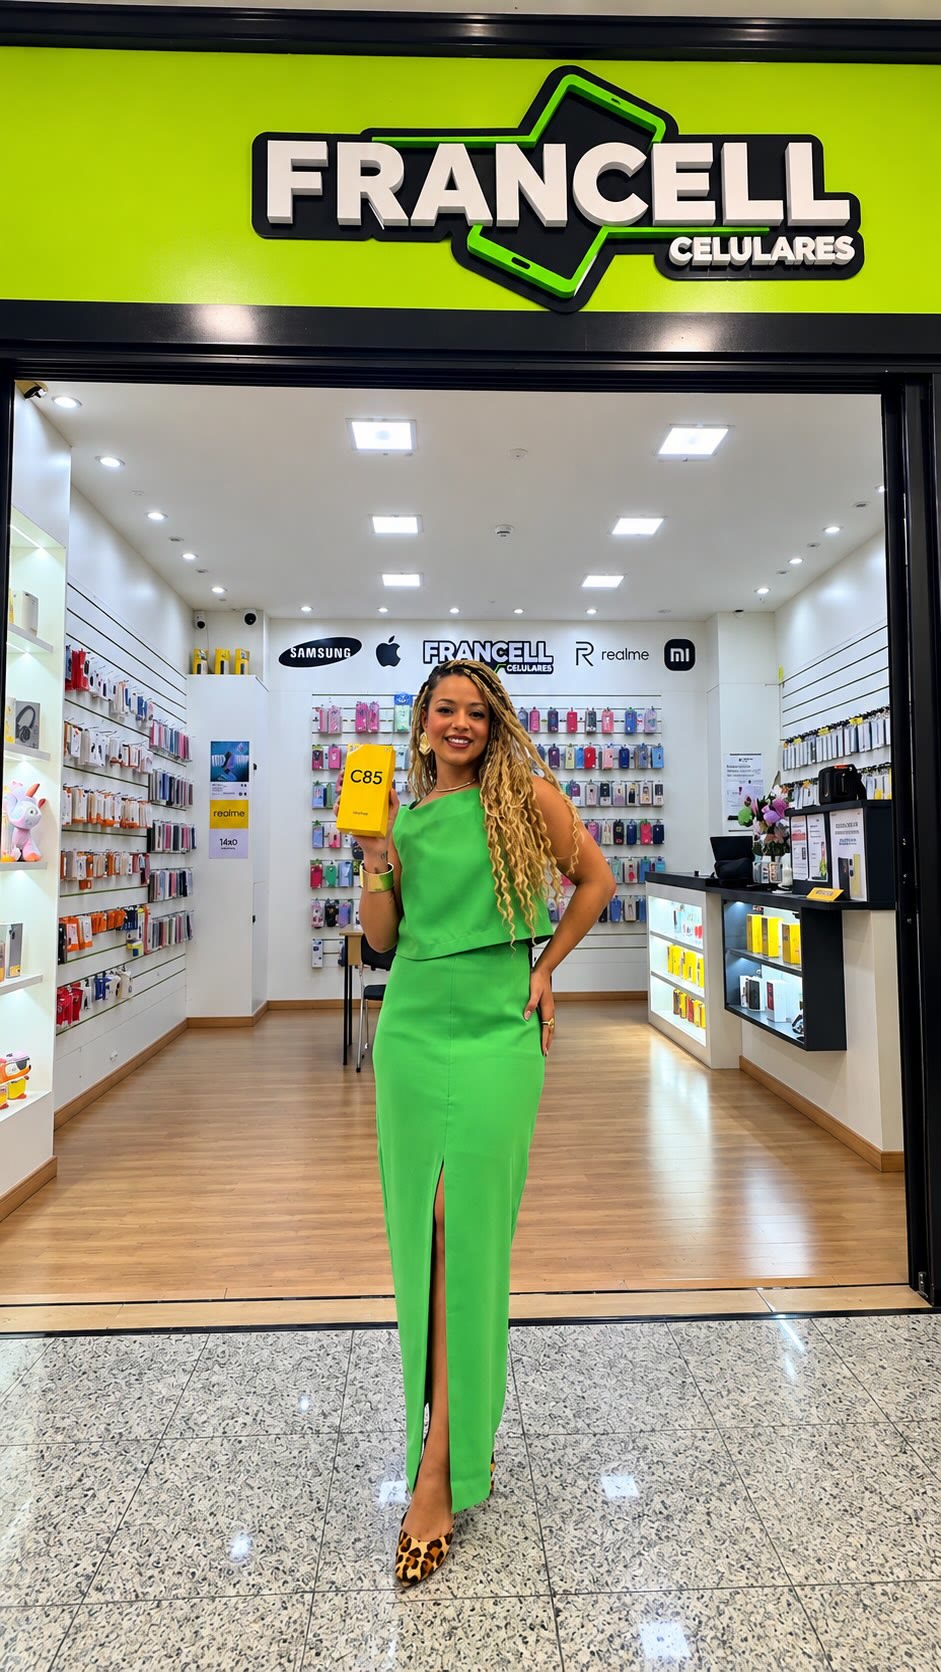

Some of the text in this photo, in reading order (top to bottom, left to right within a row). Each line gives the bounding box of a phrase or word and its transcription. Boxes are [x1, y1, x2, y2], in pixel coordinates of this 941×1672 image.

[266, 141, 851, 227] FRANCELL
[669, 236, 855, 267] CELULARES
[290, 648, 352, 660] SAMSUNG
[424, 641, 553, 663] FRANCELL
[601, 648, 650, 661] realme
[506, 664, 553, 673] CELULARES
[350, 769, 383, 785] C85
[213, 809, 245, 818] realme
